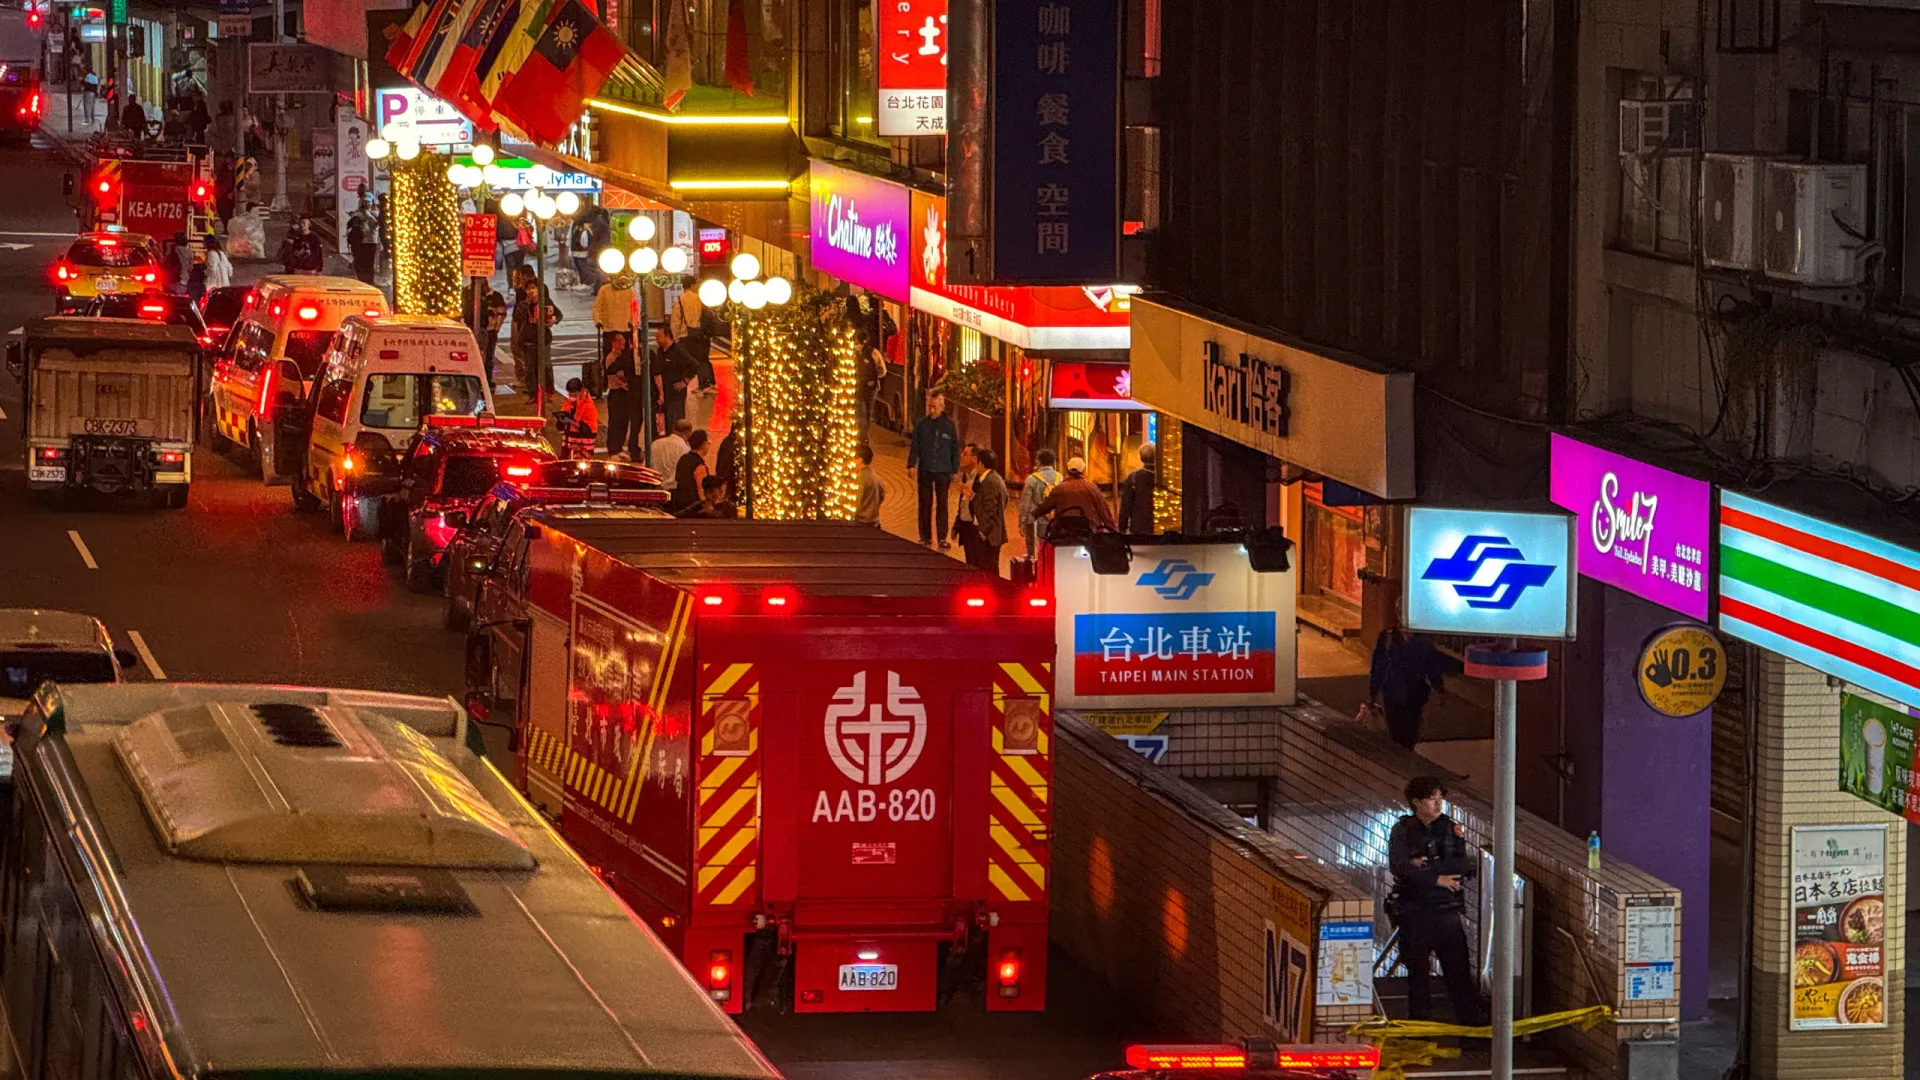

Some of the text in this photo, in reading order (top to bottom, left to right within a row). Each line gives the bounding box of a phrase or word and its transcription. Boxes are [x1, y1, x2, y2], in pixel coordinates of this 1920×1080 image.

[1038, 4, 1070, 74] 咖啡
[887, 95, 943, 109] 台北花園
[916, 116, 944, 130] 天成
[827, 193, 873, 260] Chatime
[1037, 183, 1069, 255] 空間
[983, 289, 1015, 319] Bakery
[84, 418, 137, 435] CBK-2373
[1100, 624, 1252, 663] 台北車站
[1100, 668, 1254, 683] TAIPEI MAIN STATION
[1671, 647, 1717, 681] 0.3
[812, 788, 936, 823] AAB-820
[841, 971, 896, 987] AAB-820
